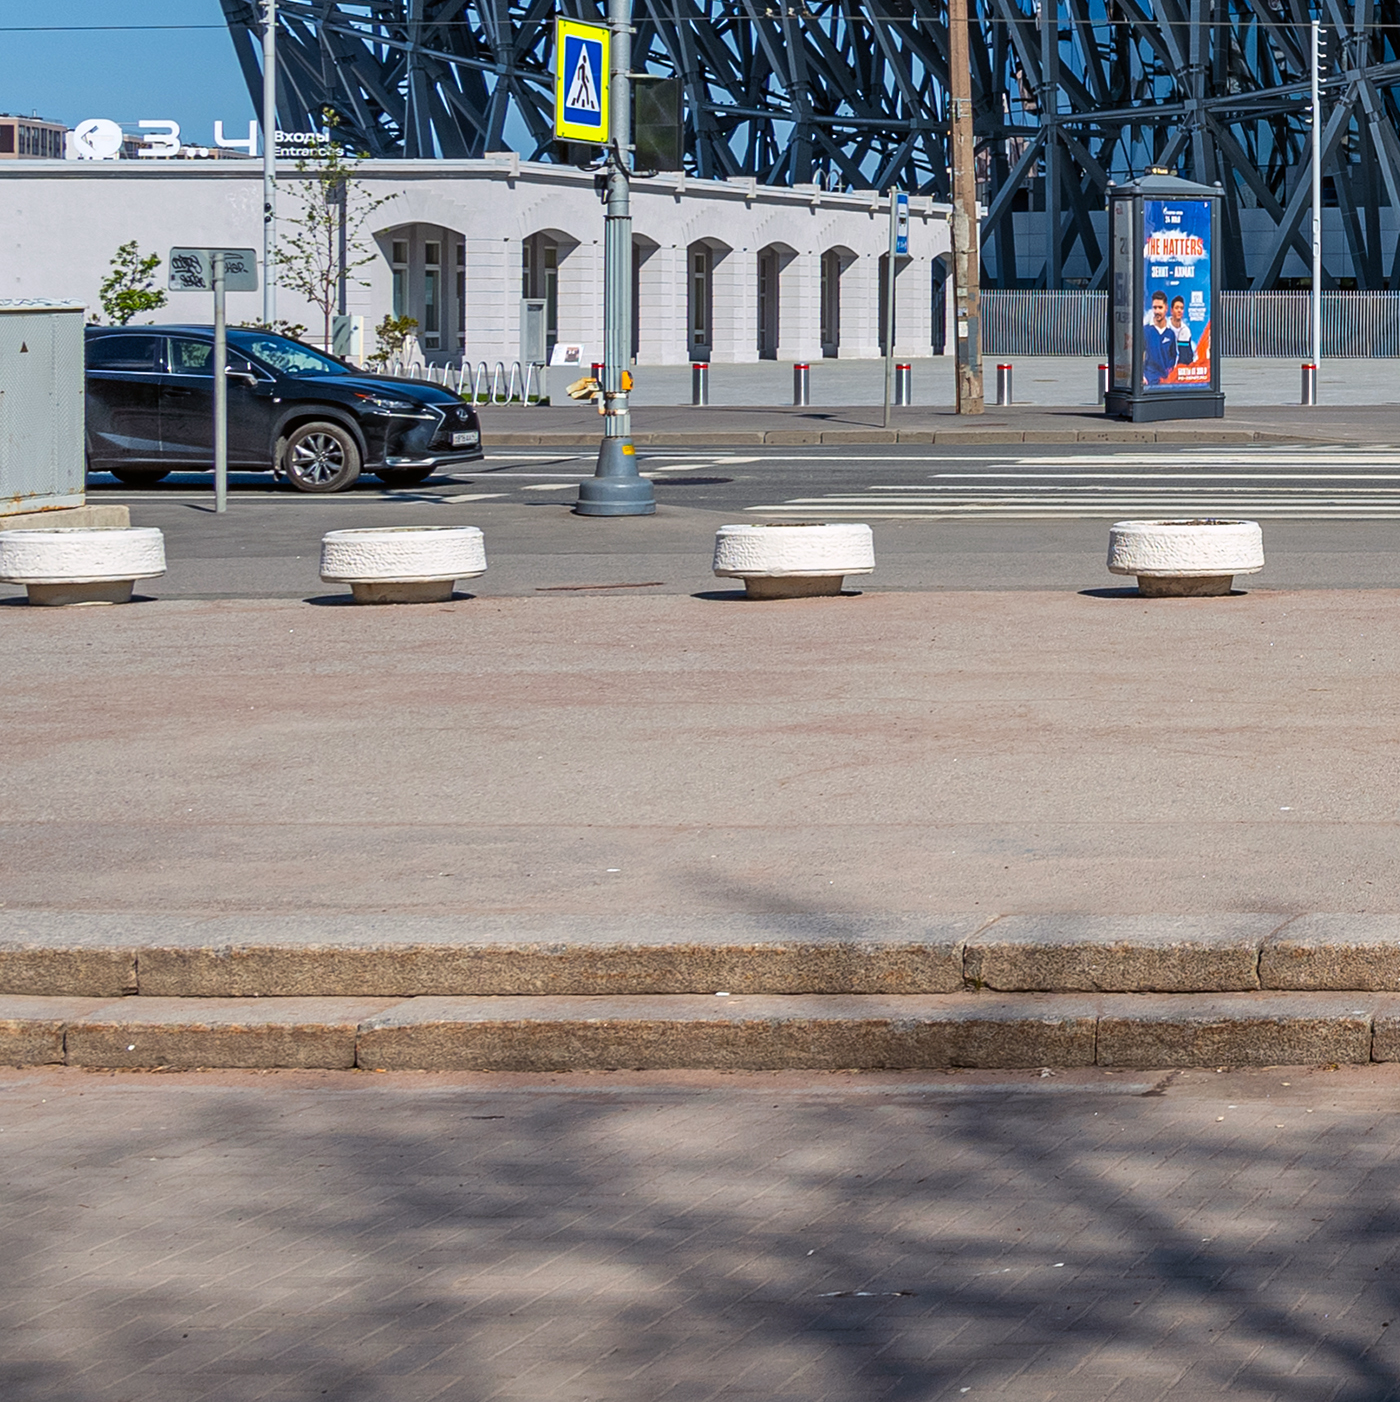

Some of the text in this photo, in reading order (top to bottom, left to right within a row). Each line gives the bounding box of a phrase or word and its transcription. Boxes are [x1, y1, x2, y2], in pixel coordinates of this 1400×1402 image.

[274, 130, 330, 145] Входы
[1146, 238, 1160, 255] THE
[1163, 238, 1204, 256] HATTERS
